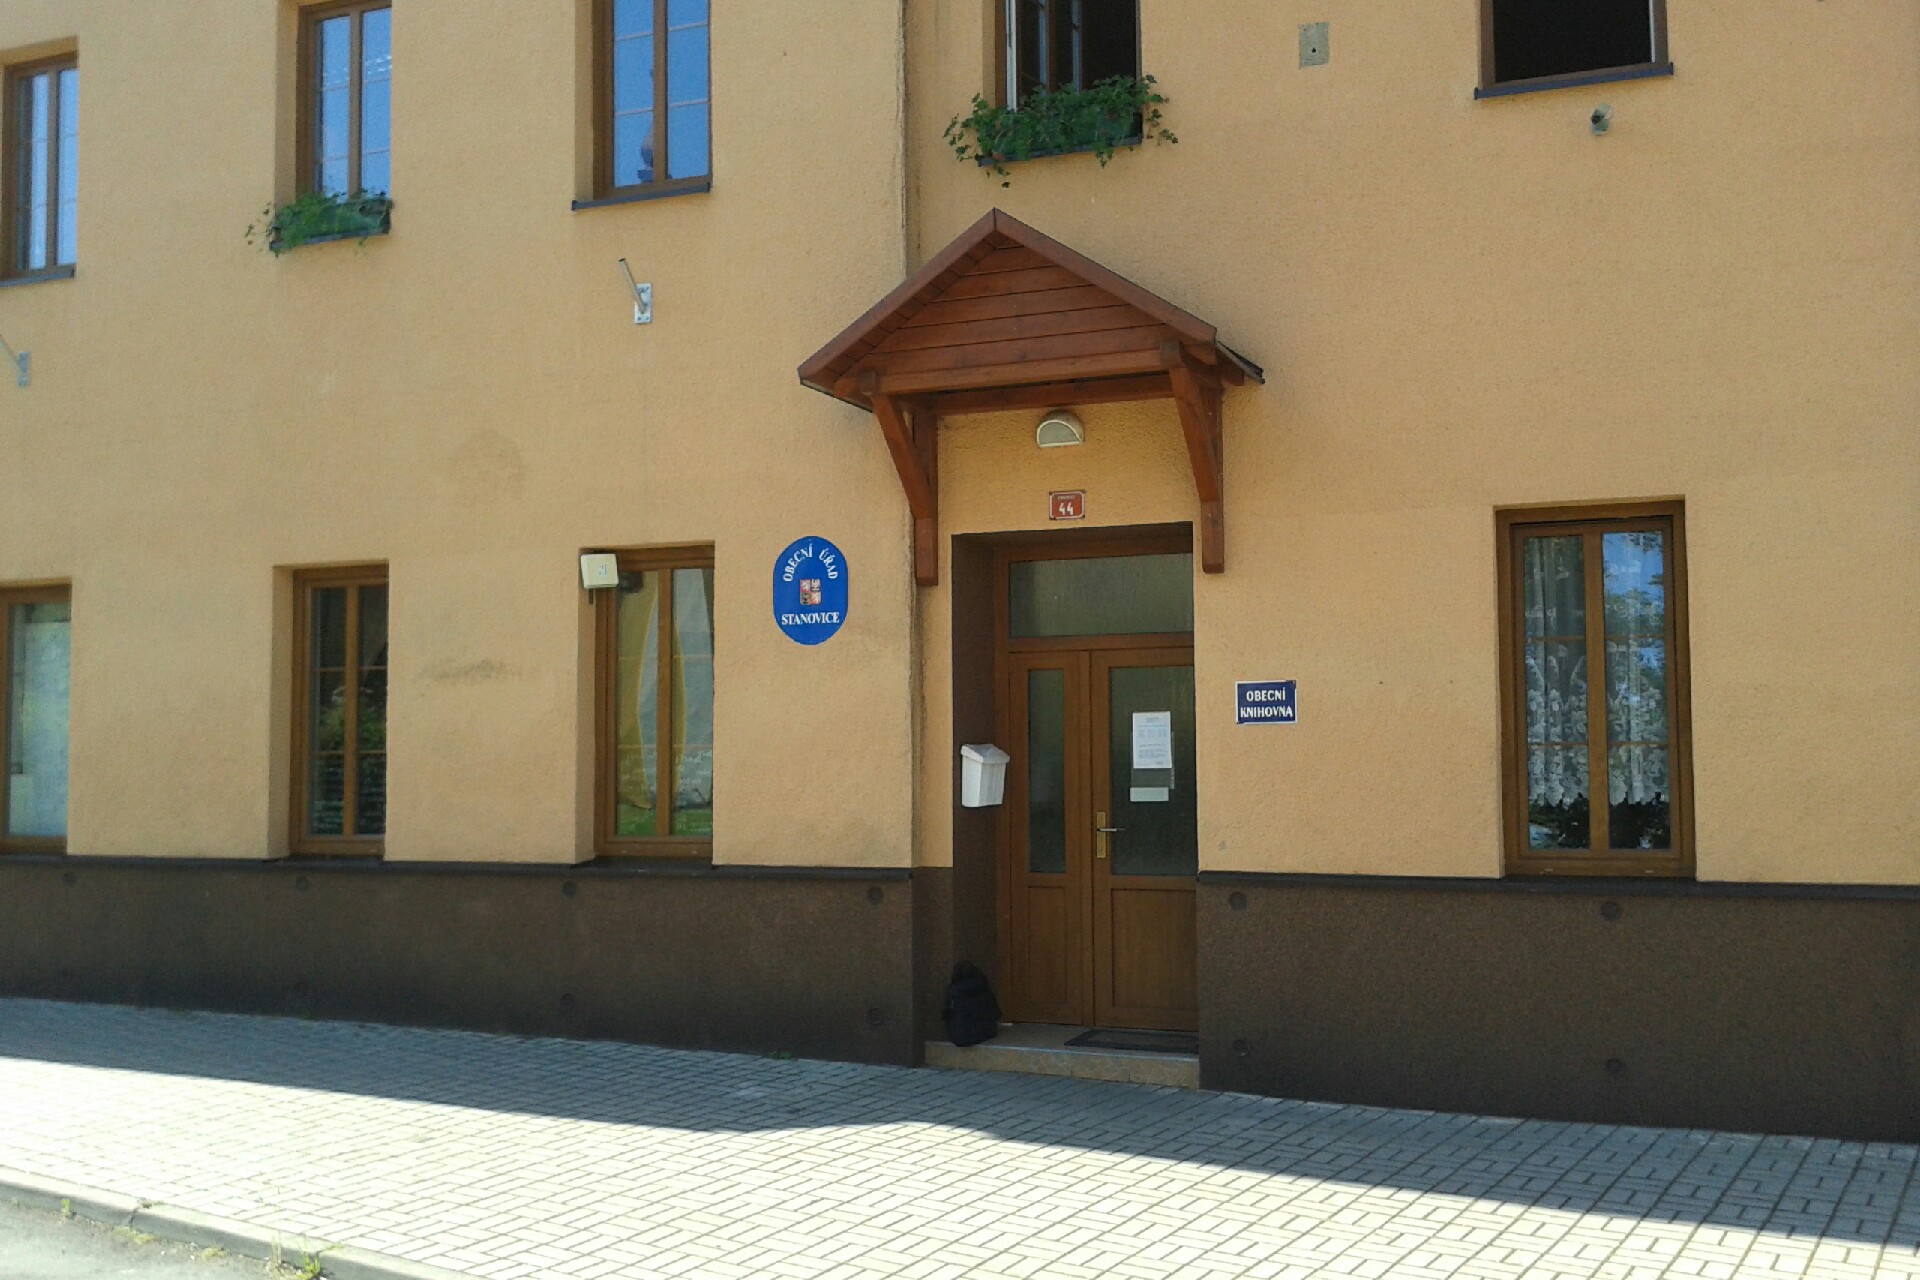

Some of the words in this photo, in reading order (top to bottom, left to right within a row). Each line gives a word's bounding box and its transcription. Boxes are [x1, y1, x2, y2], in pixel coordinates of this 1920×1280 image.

[1058, 502, 1074, 516] 44
[783, 543, 813, 582] OBECNÍ
[819, 548, 839, 579] ÚŘAD
[781, 612, 840, 626] STANOVICE
[1246, 687, 1286, 702] OBECNÍ
[1240, 705, 1293, 718] KNIHOVNA
